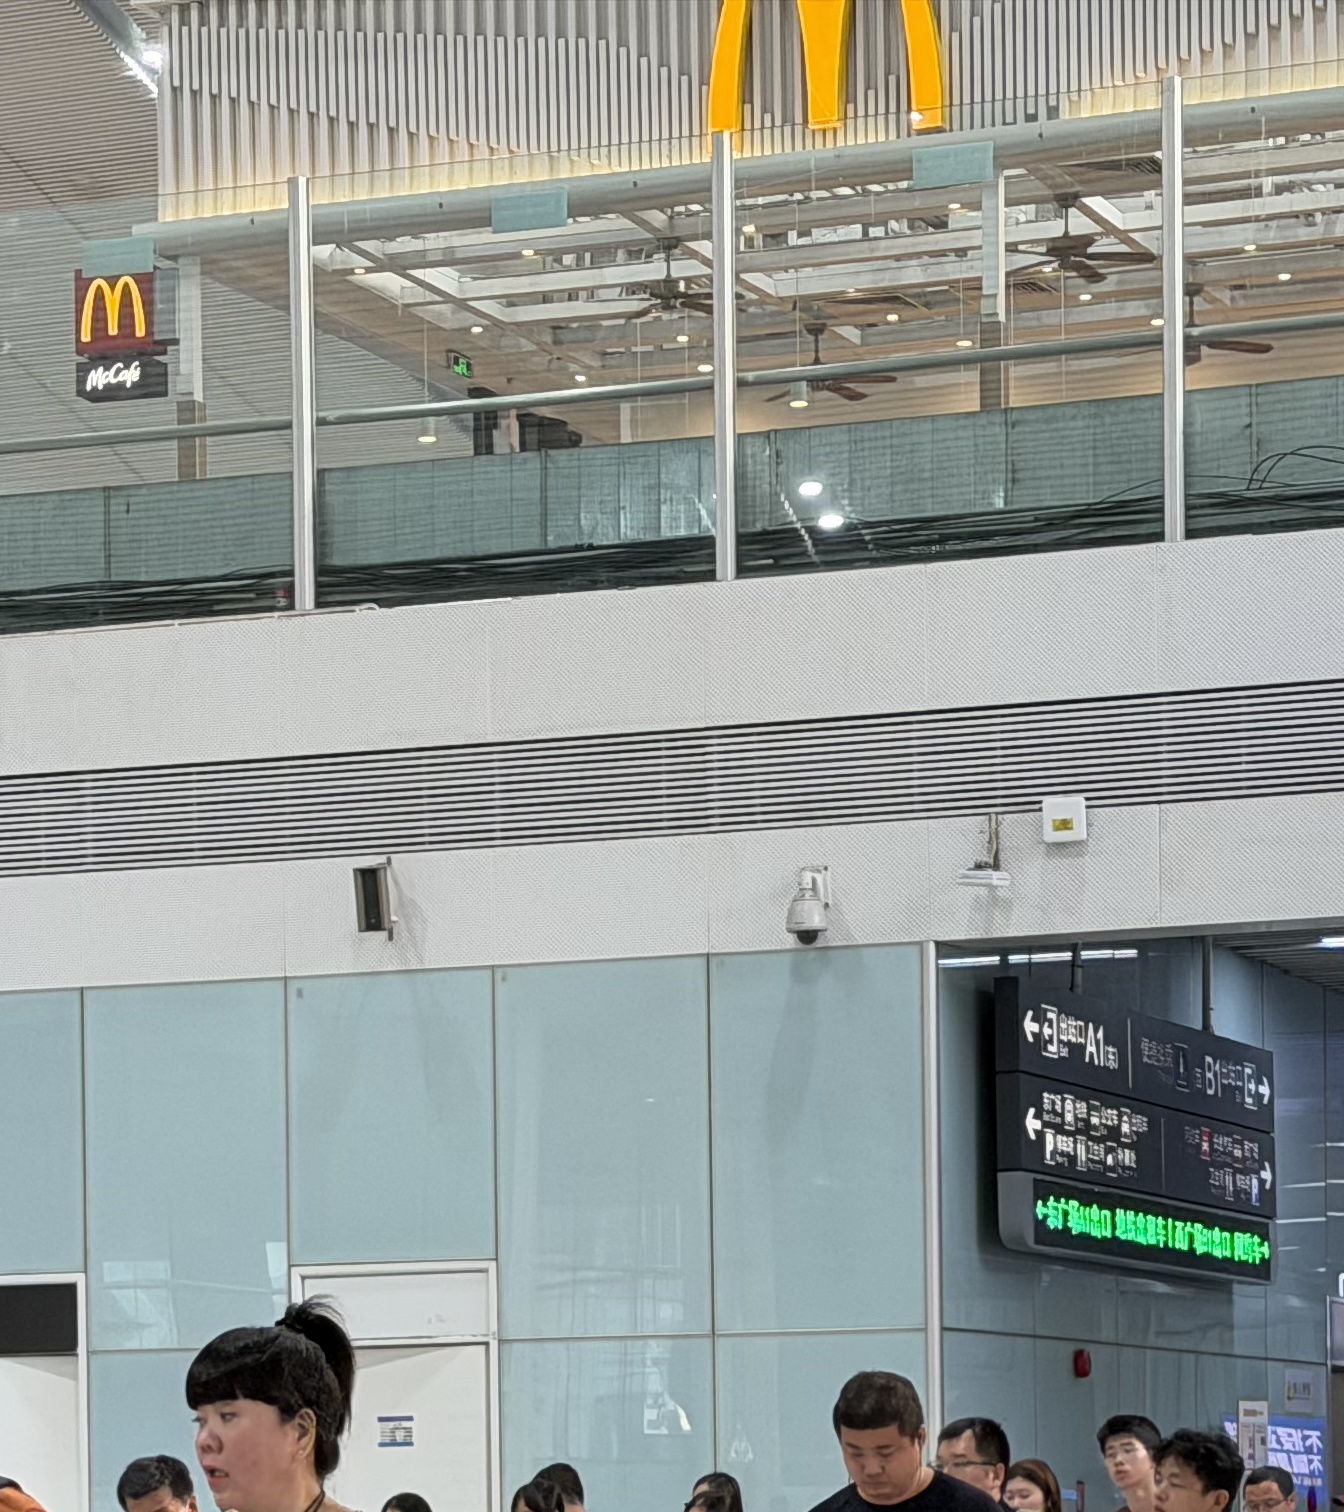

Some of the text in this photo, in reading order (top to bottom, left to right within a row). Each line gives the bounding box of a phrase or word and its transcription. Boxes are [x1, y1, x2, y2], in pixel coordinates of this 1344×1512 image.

[86, 361, 141, 391] McCafé
[1085, 1022, 1104, 1067] A1
[1204, 1055, 1222, 1097] B1
